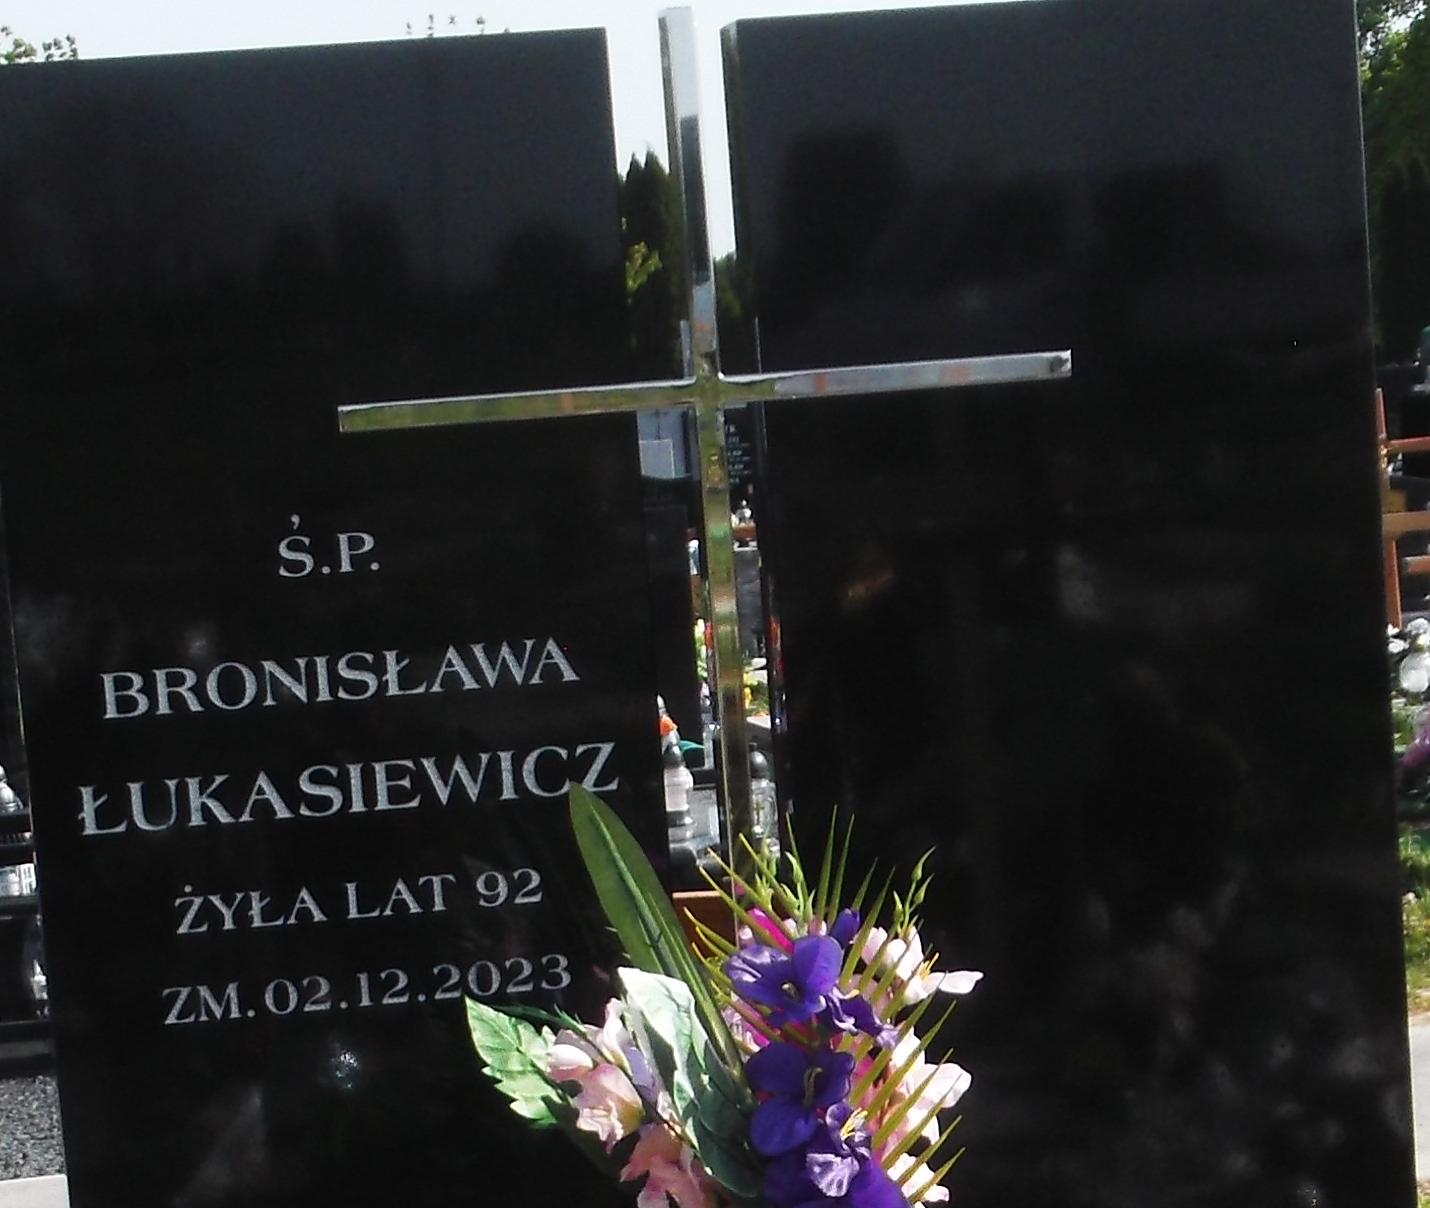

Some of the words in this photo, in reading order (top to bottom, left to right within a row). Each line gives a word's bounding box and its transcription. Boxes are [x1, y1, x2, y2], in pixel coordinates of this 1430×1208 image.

[278, 513, 381, 577] Ś.P.
[99, 636, 581, 719] BRONISŁAWA
[77, 741, 621, 836] ŁUKASIEWICZ
[173, 884, 328, 935] ŻYŁA
[344, 873, 456, 920] LAT
[475, 867, 543, 908] 92
[161, 953, 573, 1026] ZM.02.12.2023
